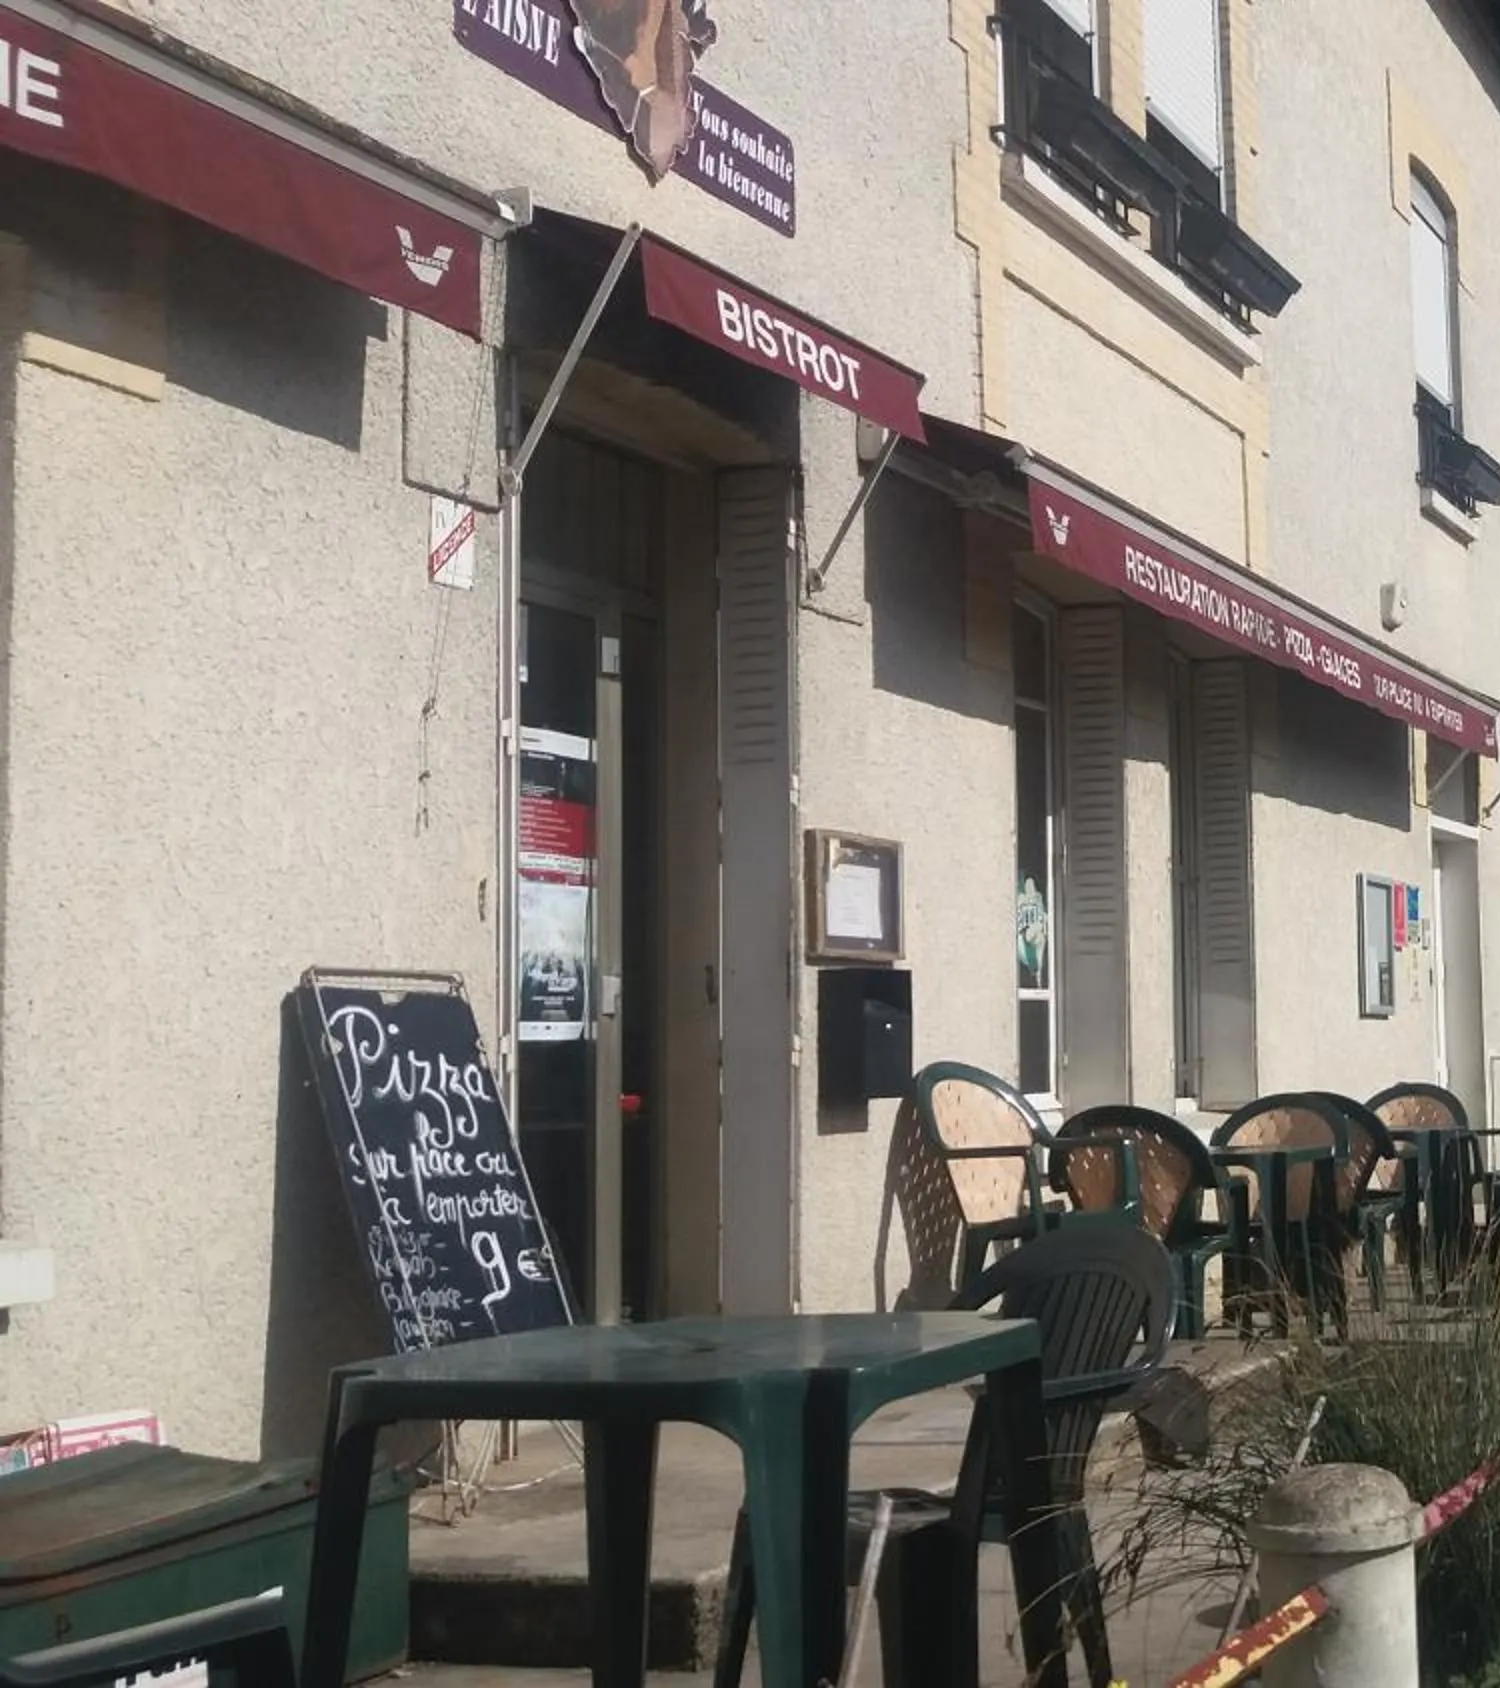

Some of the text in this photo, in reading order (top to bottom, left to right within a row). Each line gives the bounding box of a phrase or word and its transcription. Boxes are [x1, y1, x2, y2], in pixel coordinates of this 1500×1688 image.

[698, 140, 791, 223] la bienvenue
[731, 127, 793, 183] souhaite
[716, 288, 861, 400] BISTROT
[1125, 545, 1230, 628] RESTAURATION
[1231, 600, 1277, 648] RAPIDE
[1320, 645, 1361, 689] GLACES
[328, 1005, 493, 1149] Pizza
[476, 1151, 517, 1177] ou
[427, 1183, 535, 1248] emporter
